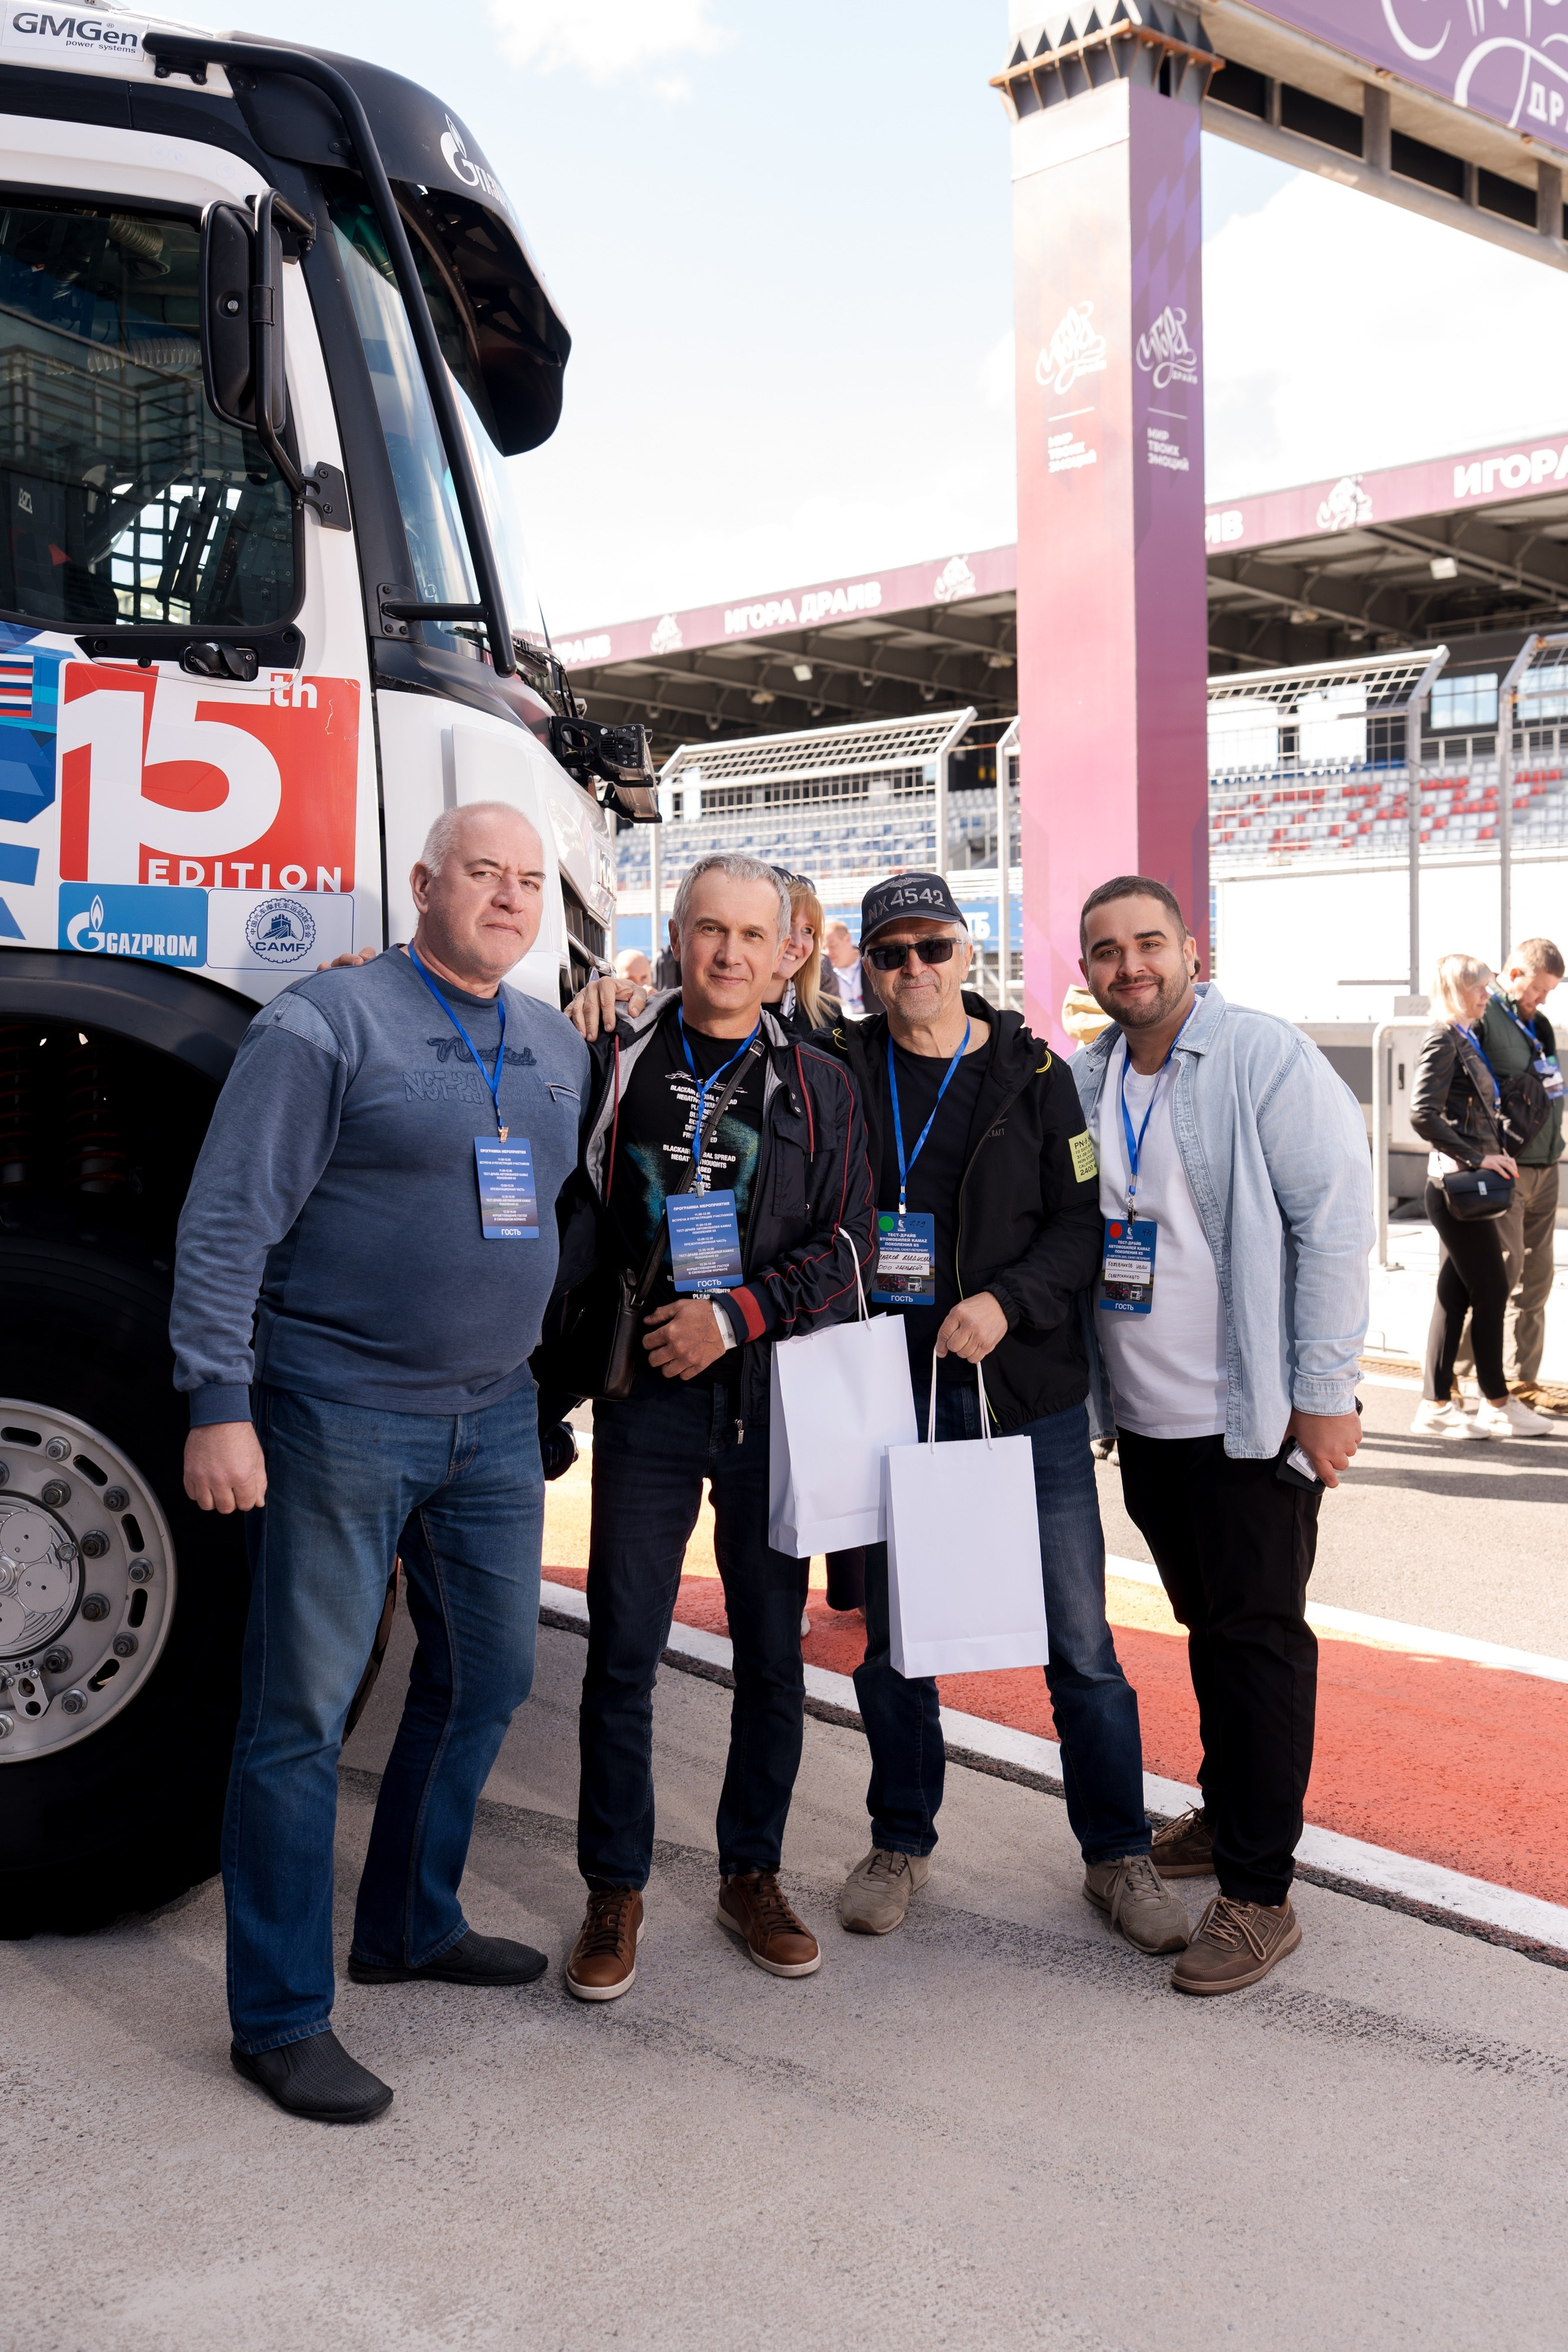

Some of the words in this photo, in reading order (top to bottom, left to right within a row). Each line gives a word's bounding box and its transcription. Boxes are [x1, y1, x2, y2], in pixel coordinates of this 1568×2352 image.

[66, 39, 94, 48] power
[99, 43, 136, 53] systems
[724, 598, 797, 635] ИГОРА
[148, 859, 342, 893] EDITION
[868, 895, 889, 924] NX
[890, 888, 946, 908] 4542
[107, 932, 197, 957] GAZPROM
[255, 942, 306, 952] CAMF
[670, 1085, 696, 1096] BLACKAIR
[696, 1091, 715, 1101] GBAL
[663, 1144, 691, 1155] BLACKAIR
[714, 1153, 736, 1162] SPREAD
[699, 1159, 727, 1169] THOUGHTS
[697, 1279, 722, 1287] ГОСТЬ
